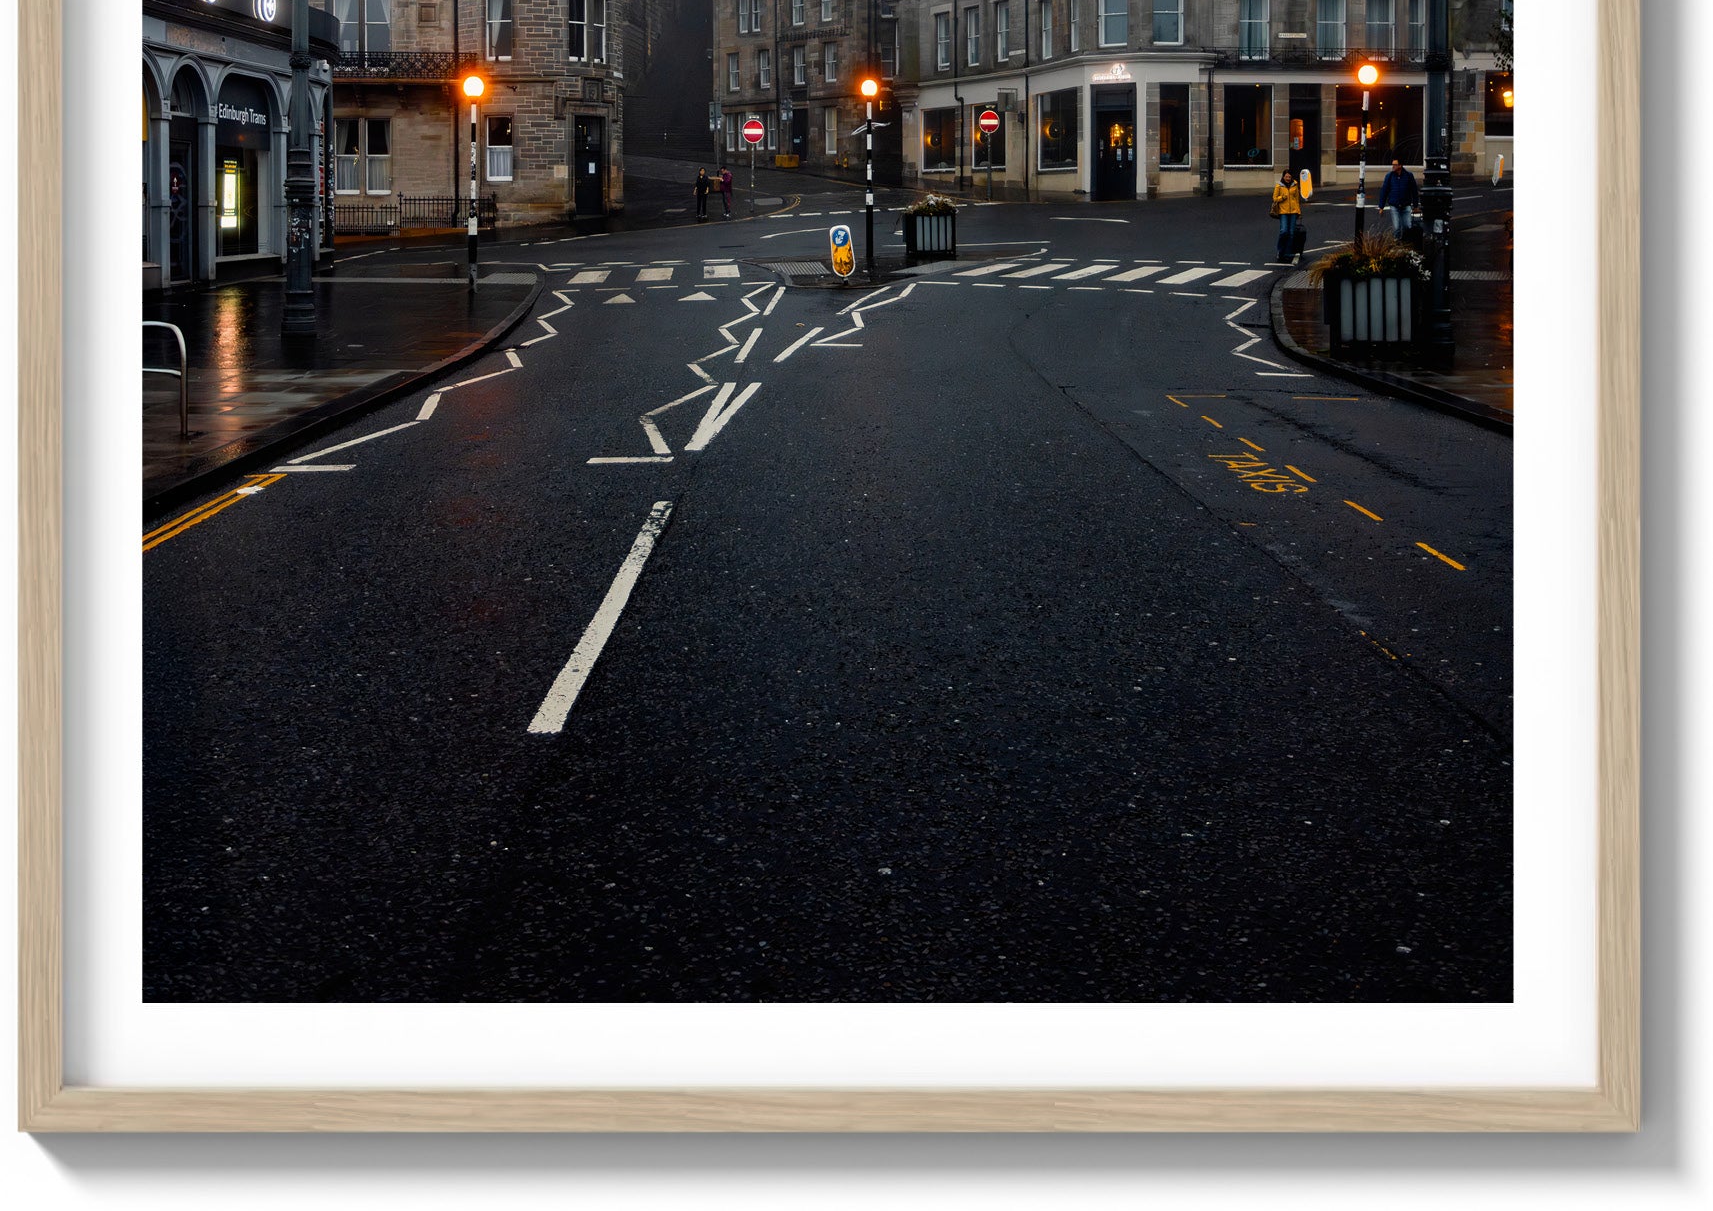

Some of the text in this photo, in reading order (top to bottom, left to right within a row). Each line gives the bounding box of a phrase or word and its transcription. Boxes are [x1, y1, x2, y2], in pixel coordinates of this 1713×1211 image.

[219, 103, 267, 126] Edinburgh Trams
[1208, 451, 1309, 493] TAXIS
